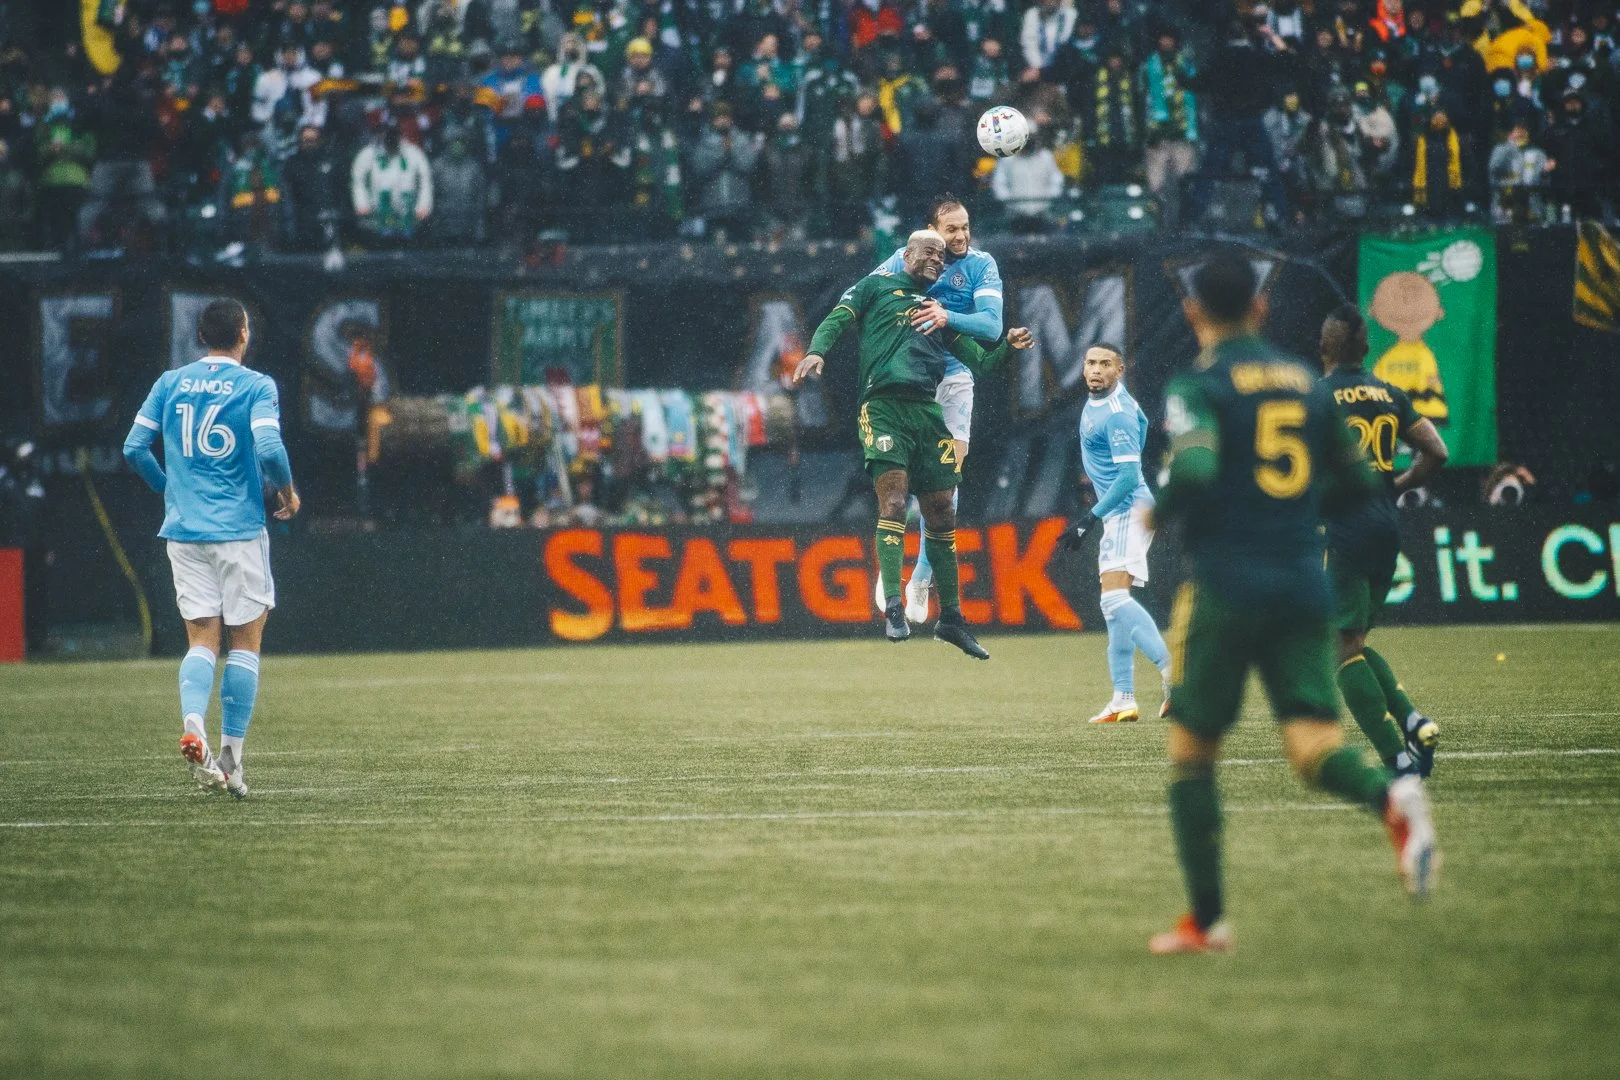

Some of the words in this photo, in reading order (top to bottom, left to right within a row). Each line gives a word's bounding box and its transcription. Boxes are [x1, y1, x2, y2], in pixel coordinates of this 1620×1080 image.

[180, 378, 234, 395] SANDS
[175, 403, 236, 459] 16
[1255, 400, 1311, 499] 5
[1434, 525, 1518, 602] it.
